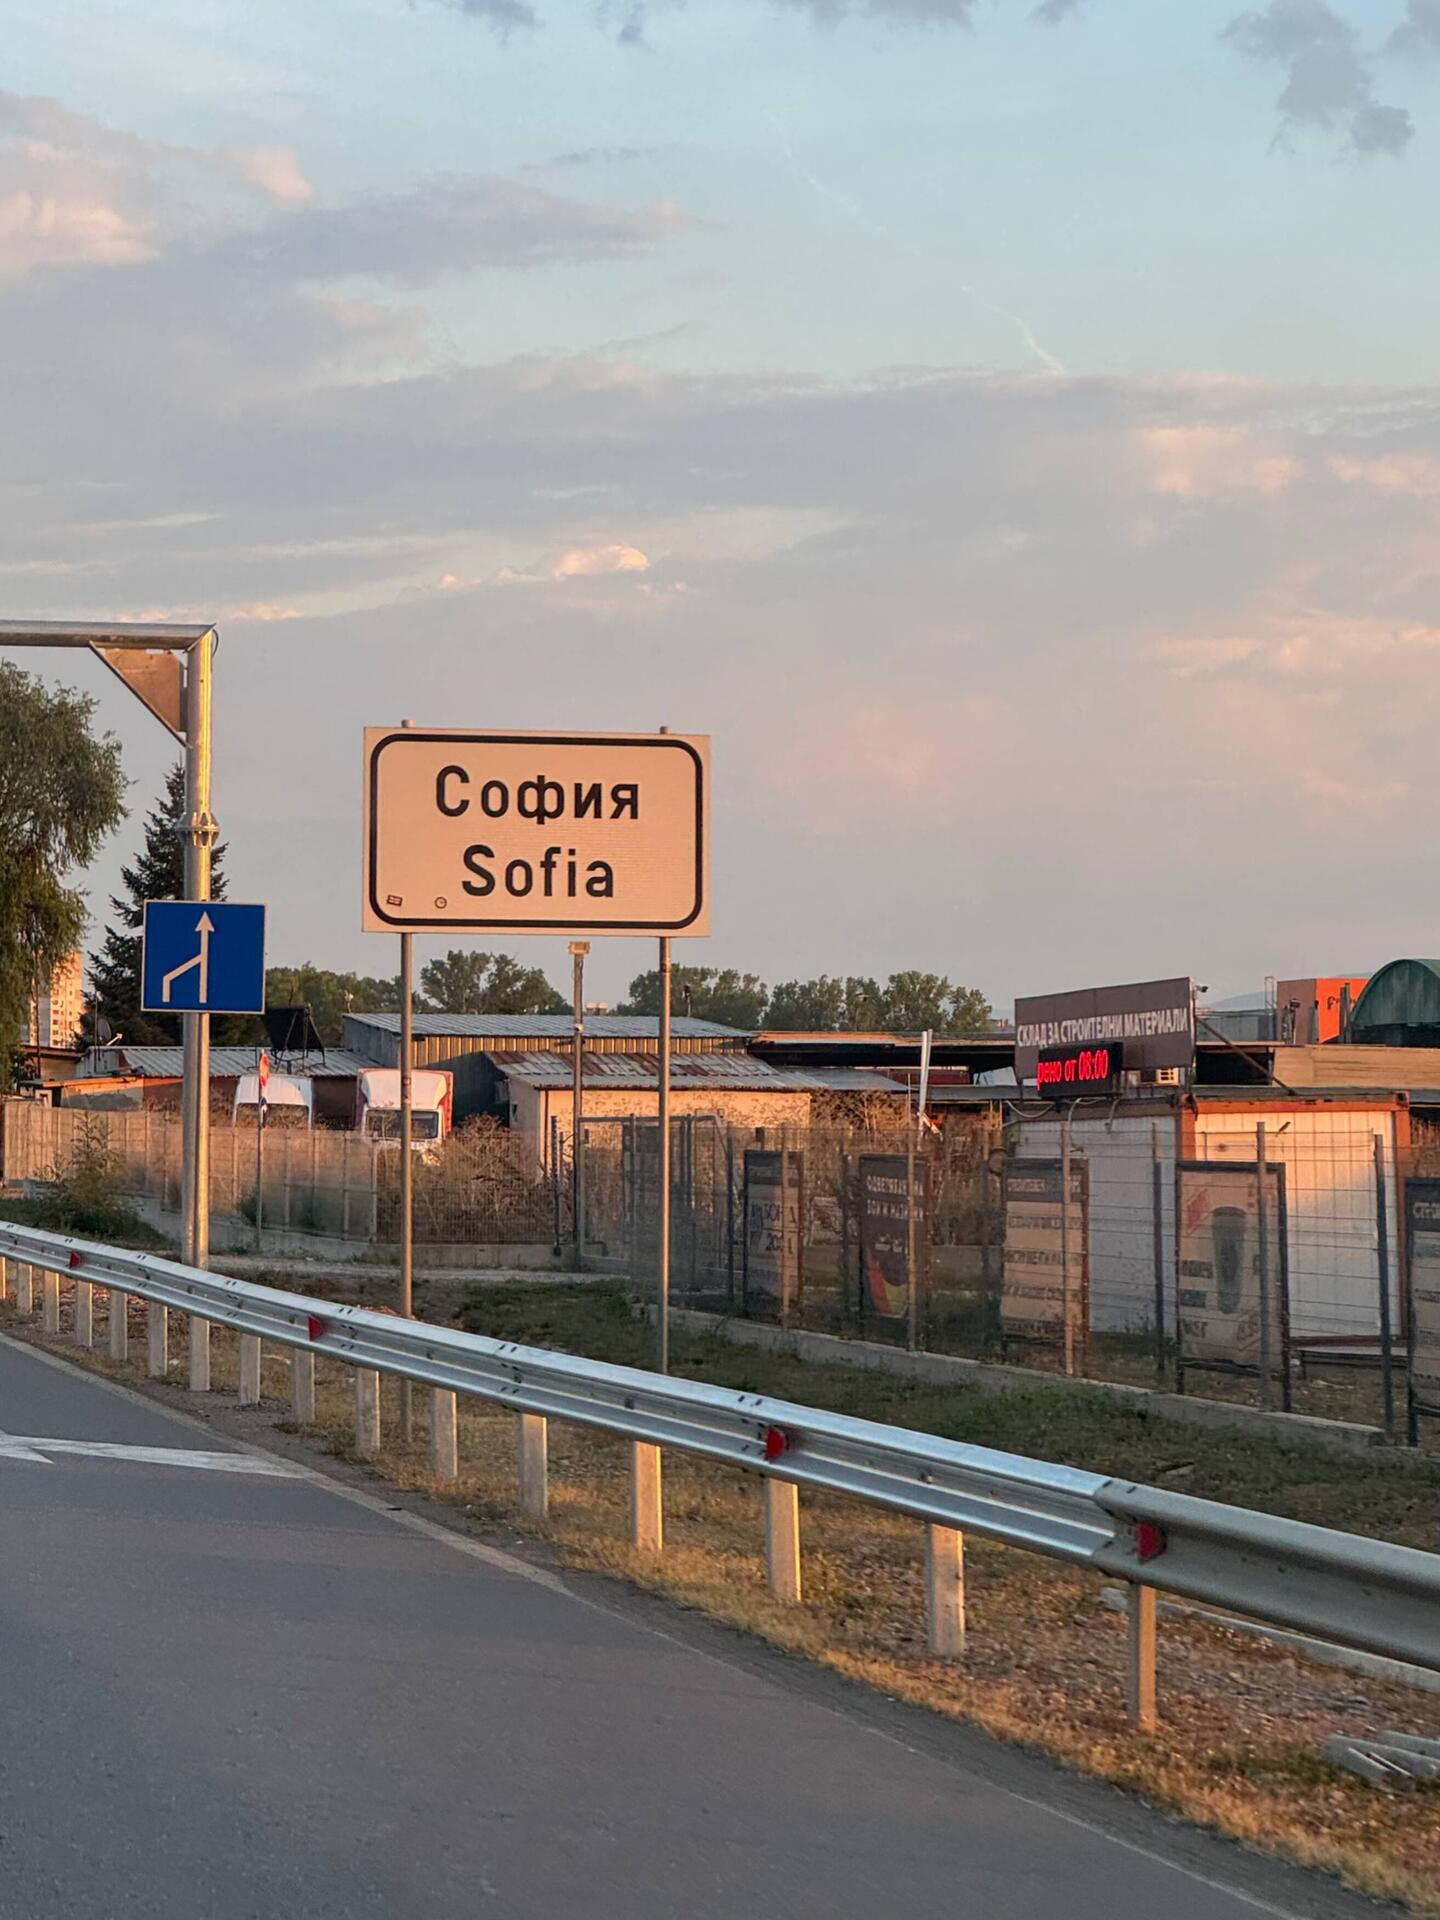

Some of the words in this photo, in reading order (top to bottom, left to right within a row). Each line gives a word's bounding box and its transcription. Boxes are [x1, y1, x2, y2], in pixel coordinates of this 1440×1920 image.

[436, 765, 639, 825] София
[461, 845, 614, 898] Sofia
[1017, 1024, 1048, 1050] СКЛАД
[1047, 1021, 1060, 1045] ЗА
[1060, 1014, 1123, 1043] СТРОИТЕЛНИ
[1124, 1007, 1188, 1038] МАТЕРИАЛИ
[1078, 1049, 1109, 1081] 08:00
